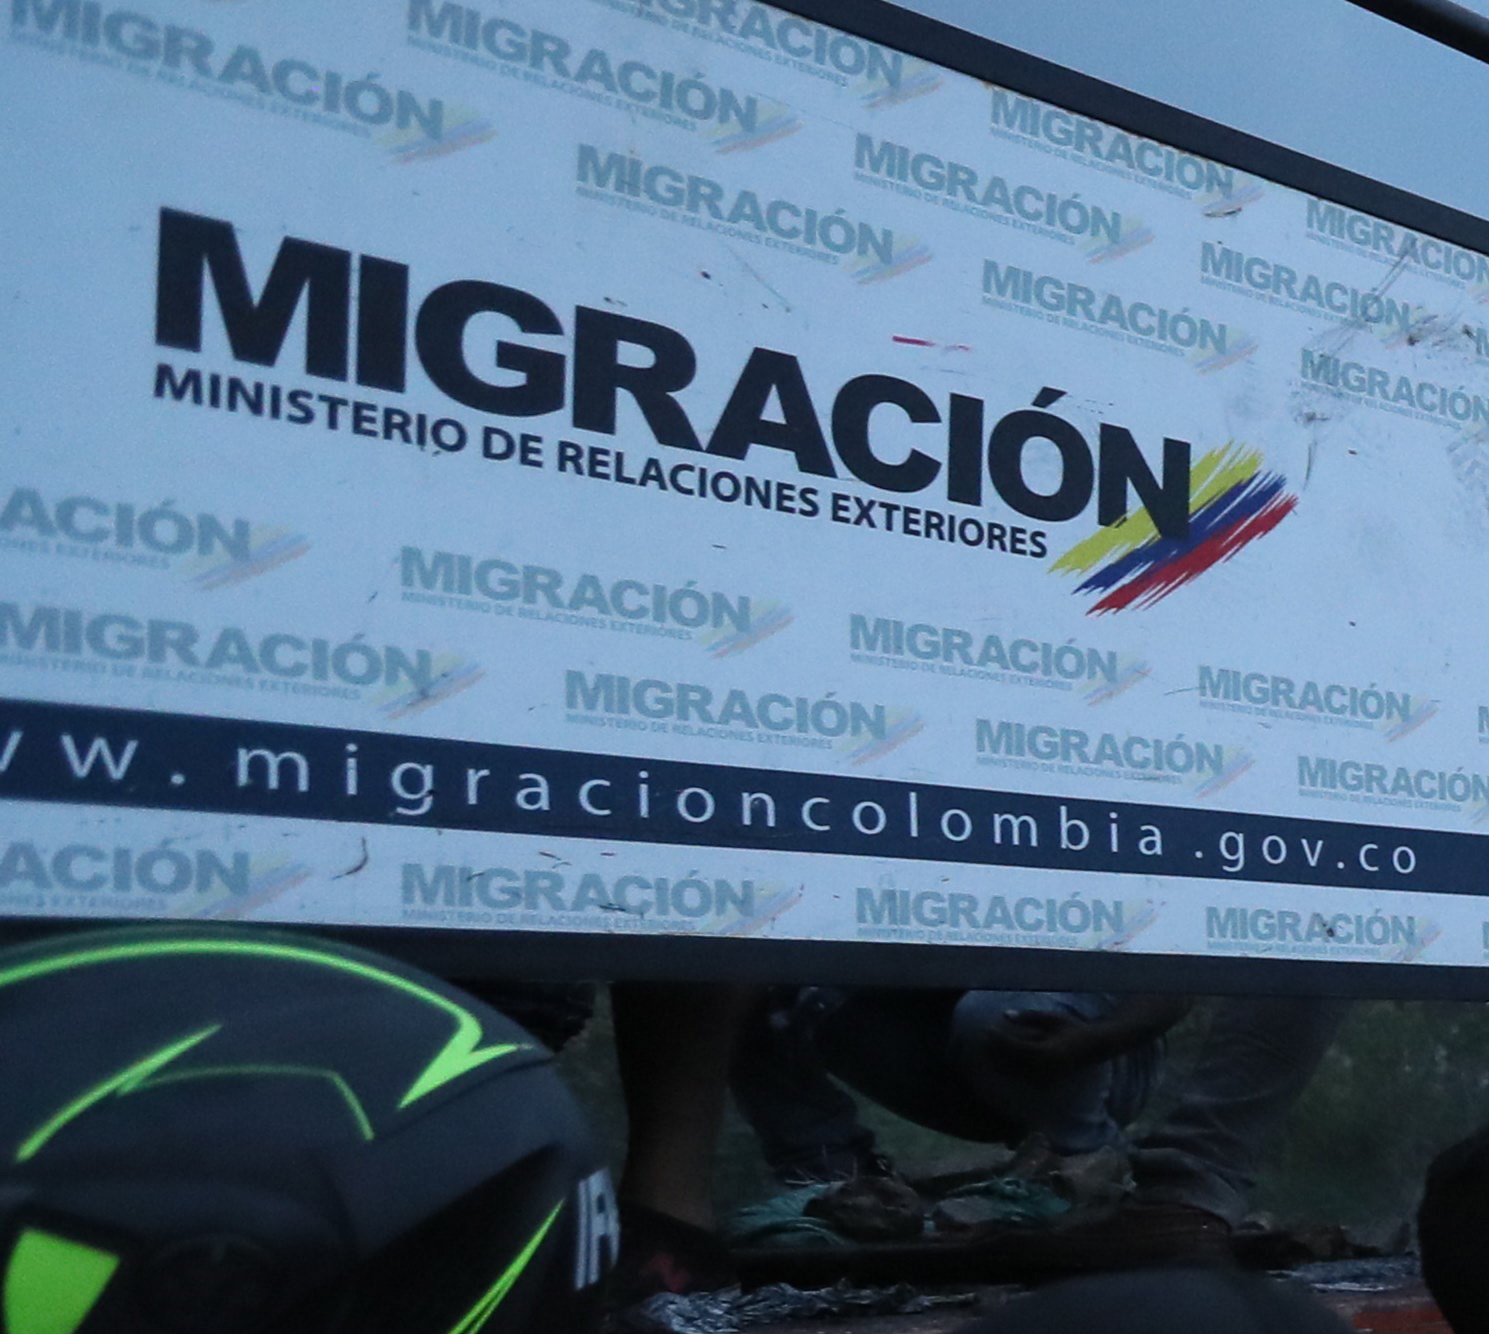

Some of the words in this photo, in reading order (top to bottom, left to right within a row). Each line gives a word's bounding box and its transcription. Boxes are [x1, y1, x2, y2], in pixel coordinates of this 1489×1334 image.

[576, 143, 893, 265] MIGRACIÓN
[855, 132, 1121, 245] MIGRACIÓN
[983, 258, 1227, 355] MIGRACIÓN
[154, 206, 1191, 539] MIGRACIÓN
[153, 363, 468, 452] MINISTERIO
[483, 427, 544, 468] DE
[557, 440, 821, 517] RELACIONES
[830, 493, 1048, 559] EXTERIORES
[400, 545, 752, 631] MIGRACIÓN
[0, 604, 431, 693] MIGRACIÓN
[849, 614, 1118, 684] MIGRACIÓN
[565, 669, 886, 740] MIGRACIÓN
[1200, 665, 1410, 723] MIGRACIÓN
[976, 718, 1223, 776] MIGRACIÓN
[401, 863, 754, 916] MIGRACIÓN
[855, 888, 1123, 933] MIGRACIÓN
[1206, 907, 1415, 945] MIGRACIÓN
